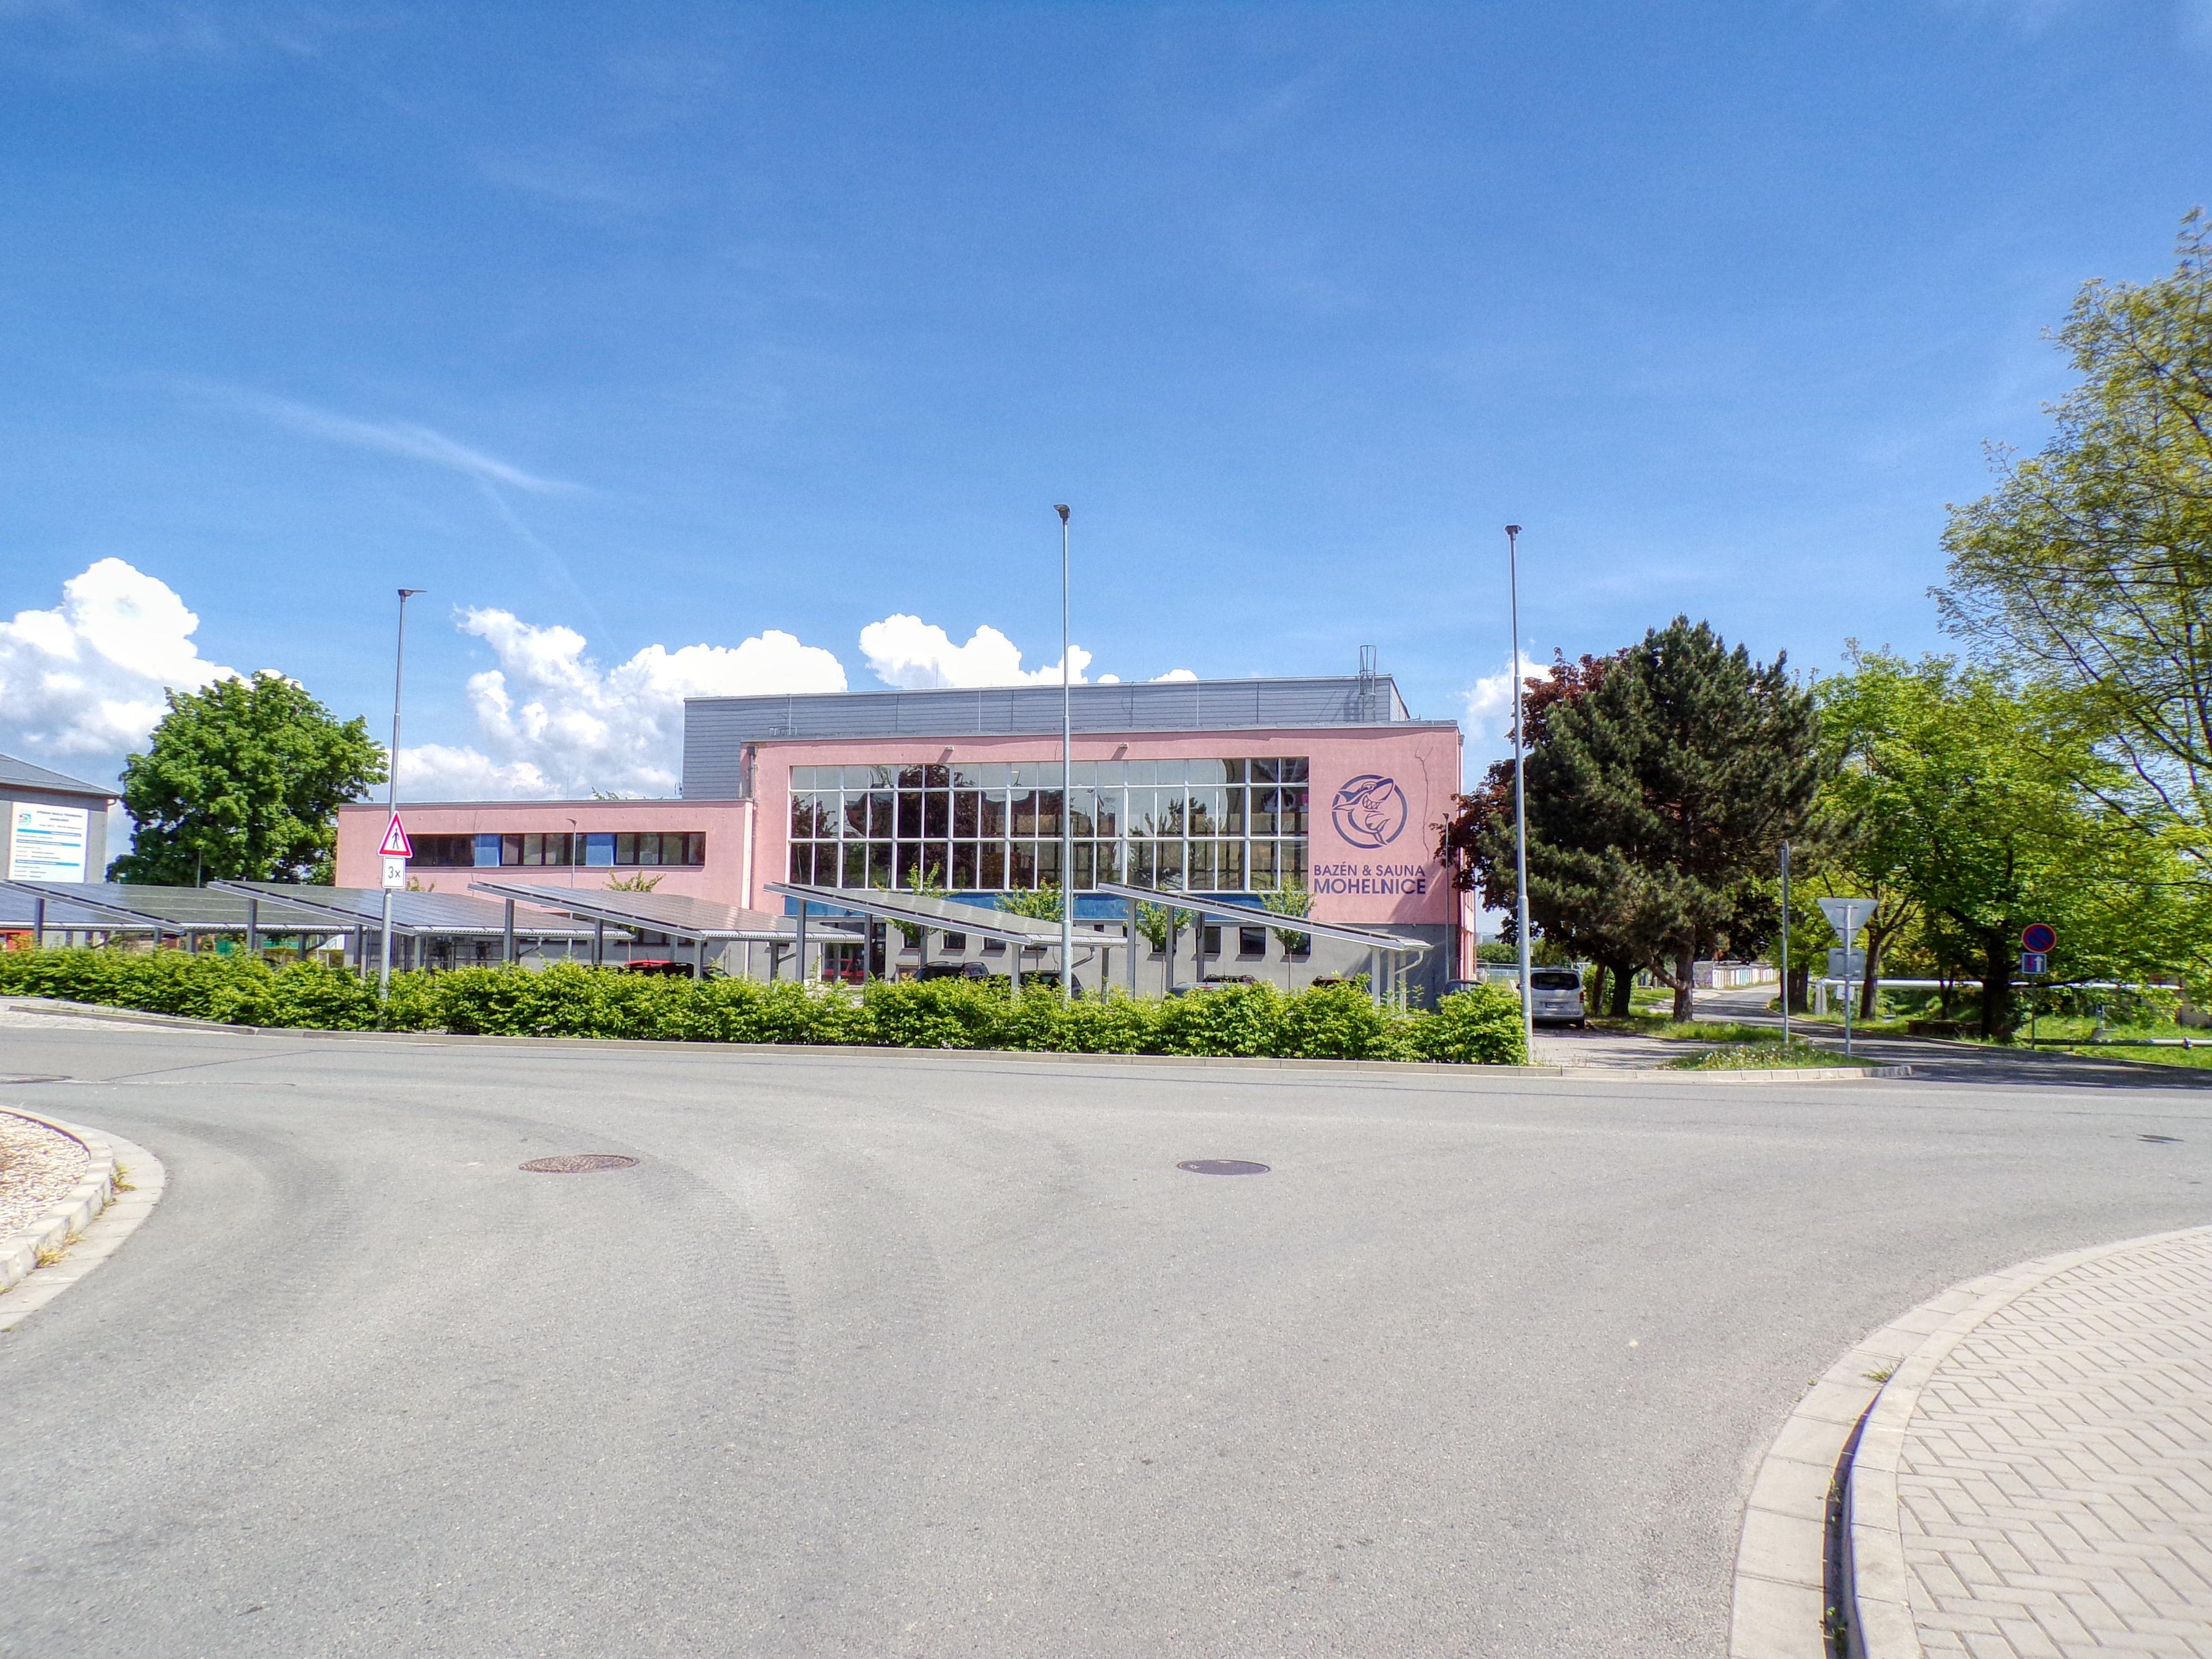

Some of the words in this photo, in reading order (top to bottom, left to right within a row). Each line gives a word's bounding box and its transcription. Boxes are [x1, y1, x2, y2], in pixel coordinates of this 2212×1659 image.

[1314, 861, 1358, 877] BAZÉN
[1362, 865, 1371, 876] &
[1375, 865, 1426, 877] SAUNA
[1314, 878, 1426, 894] MOHELNICE
